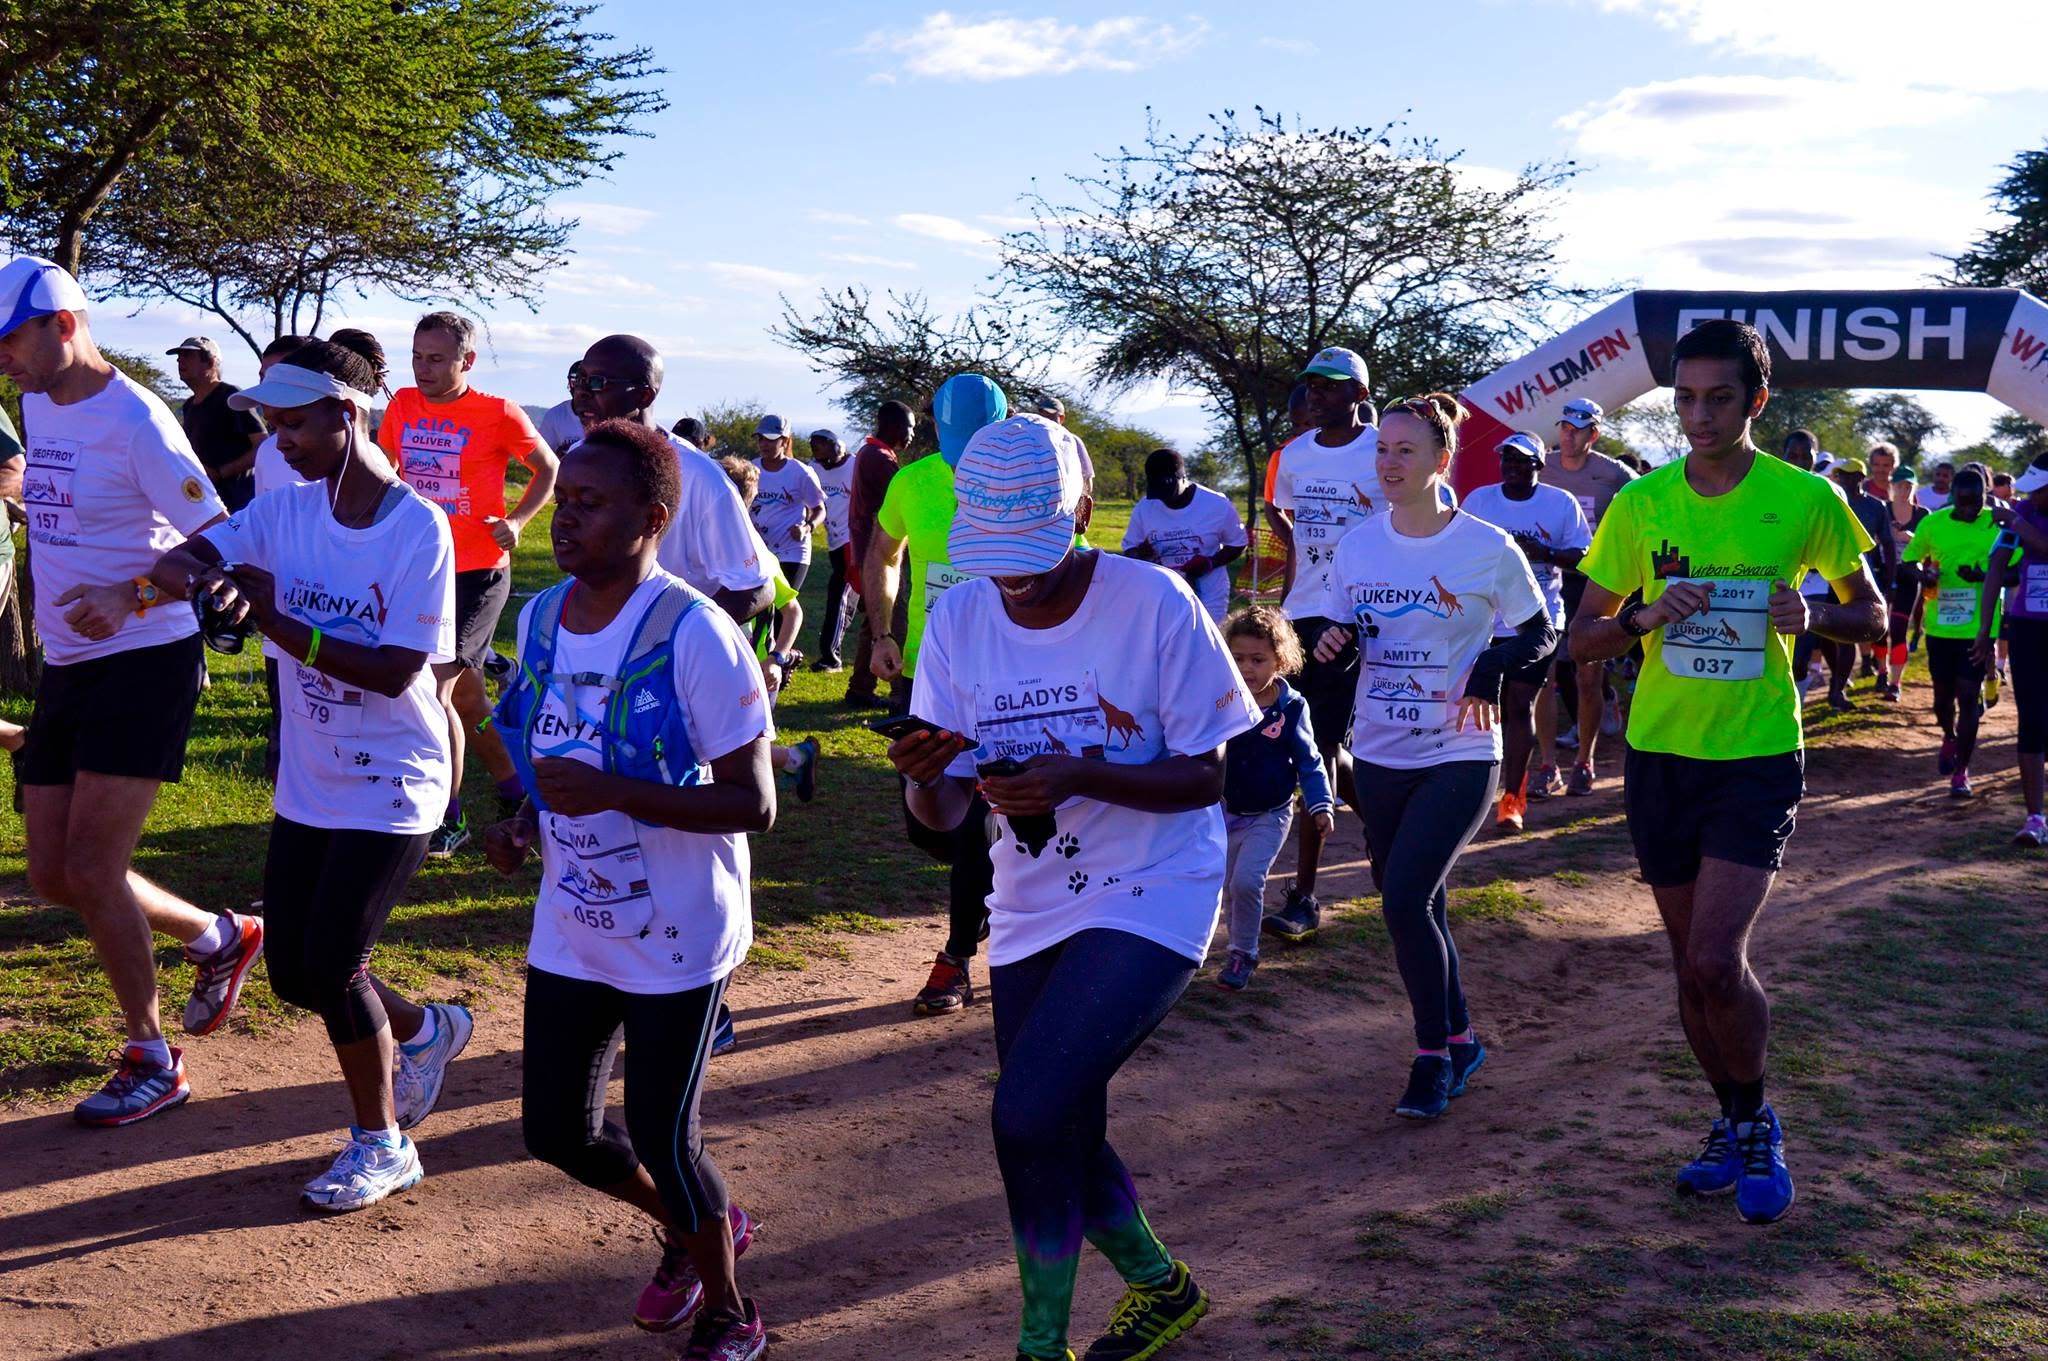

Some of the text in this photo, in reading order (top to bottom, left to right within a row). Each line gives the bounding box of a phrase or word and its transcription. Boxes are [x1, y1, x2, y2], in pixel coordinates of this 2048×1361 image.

[1676, 307, 1967, 361] FNISH
[412, 436, 451, 447] OLIVER
[32, 448, 75, 463] GEOFFROY
[416, 480, 440, 492] 049
[36, 512, 59, 529] 157
[1307, 528, 1326, 538] 133
[1709, 588, 1755, 599] 5.2017
[1383, 649, 1431, 661] AMITY
[1693, 657, 1734, 675] 037
[995, 685, 1079, 711] GLADYS
[1385, 705, 1420, 721] 140
[574, 904, 615, 930] 058
